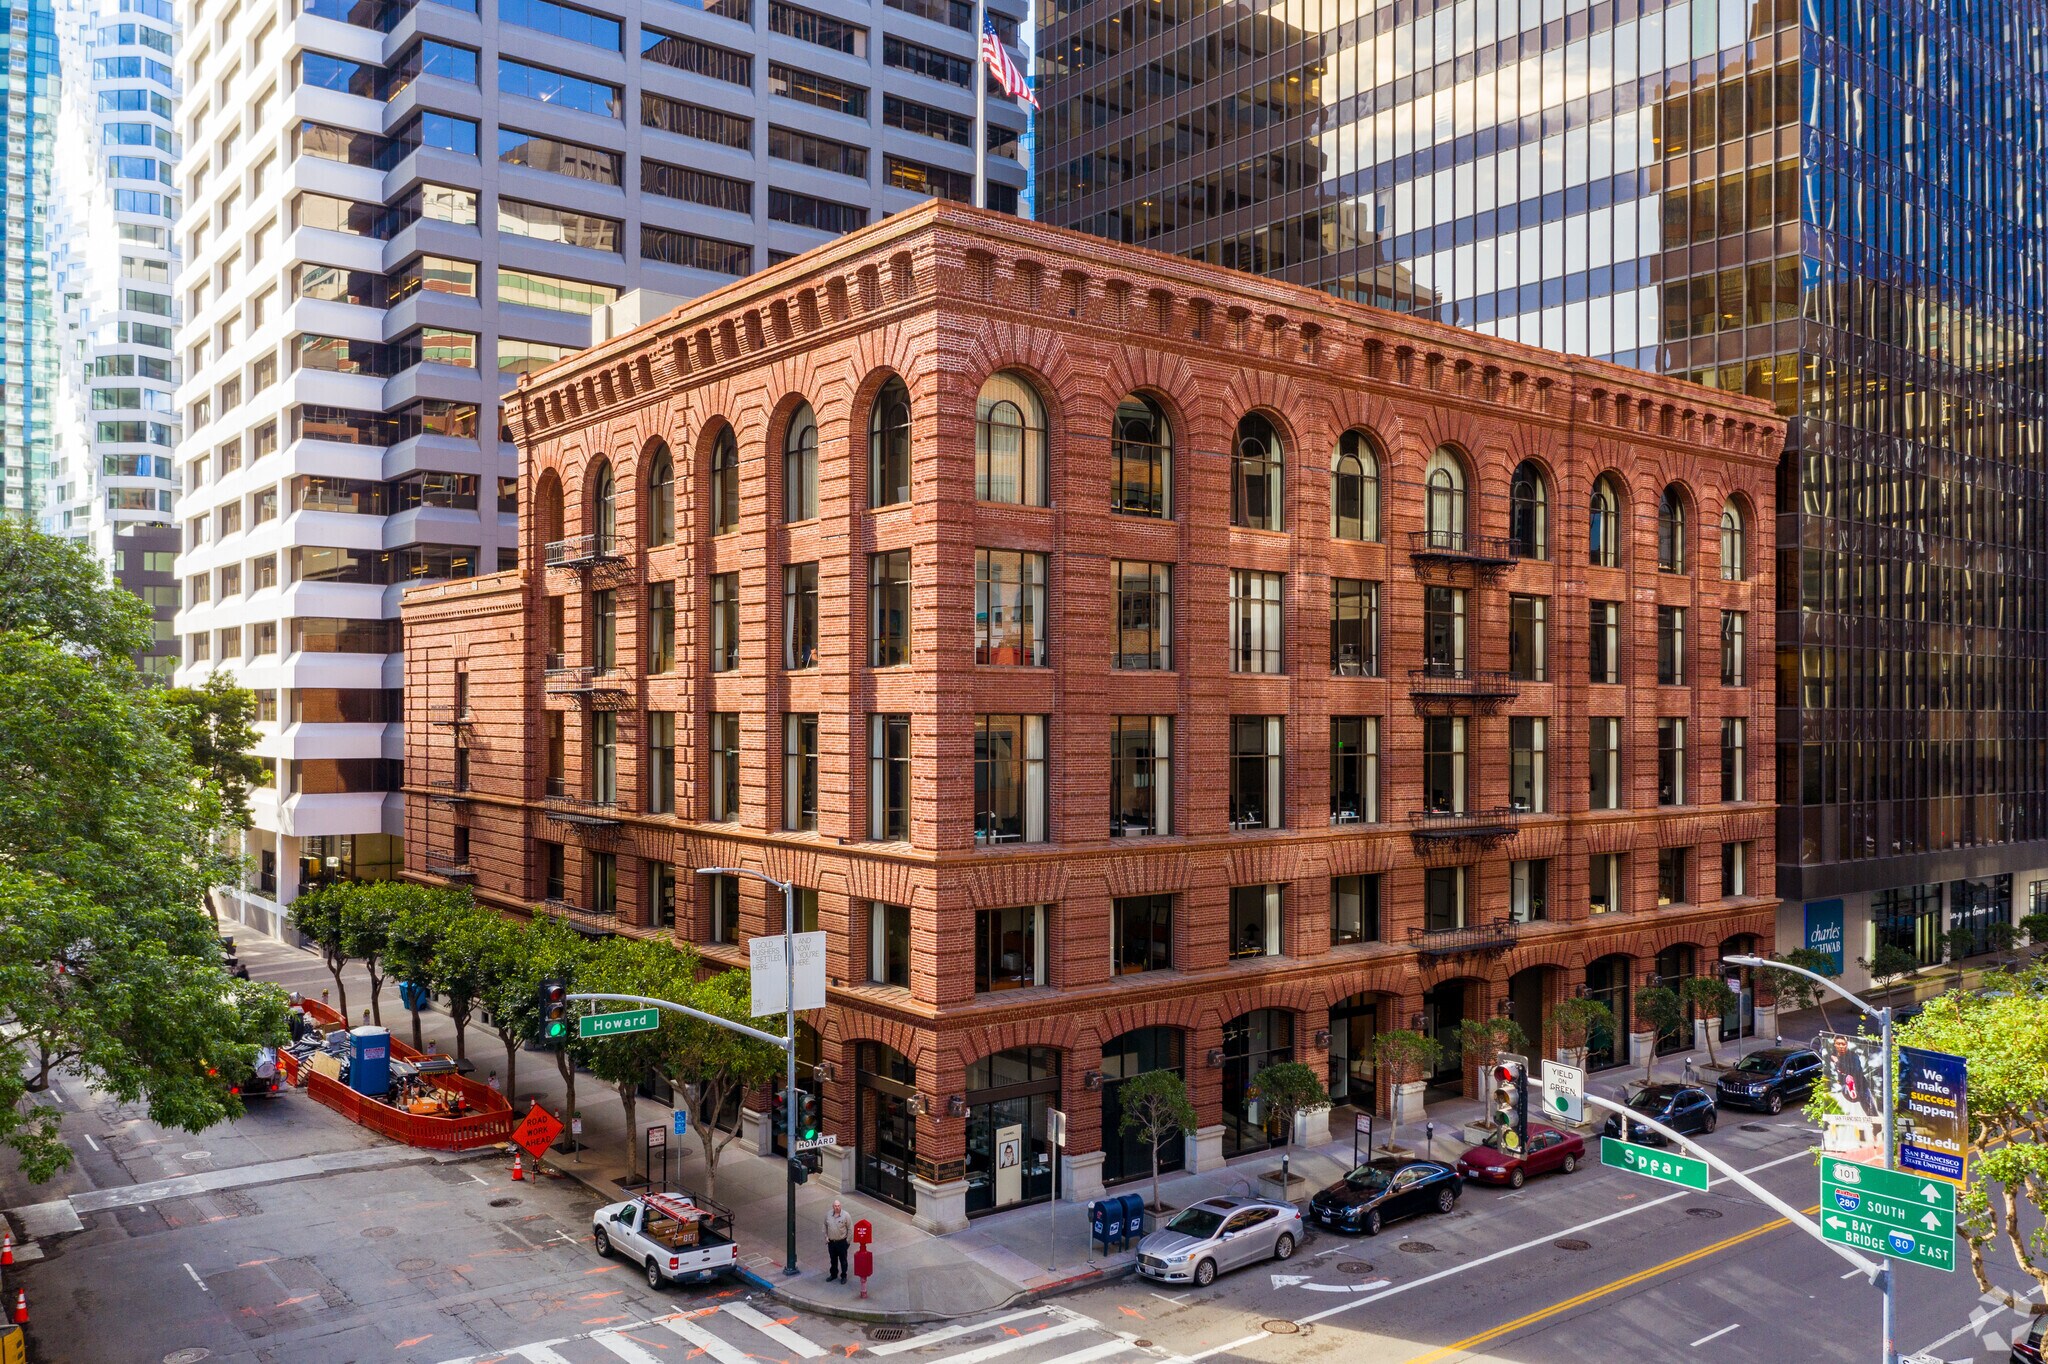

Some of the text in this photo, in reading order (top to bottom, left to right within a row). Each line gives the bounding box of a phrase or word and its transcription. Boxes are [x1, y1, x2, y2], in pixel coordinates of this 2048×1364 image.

[1810, 921, 1841, 943] charles
[756, 940, 774, 948] GOLD
[752, 948, 780, 956] RUSHERS
[756, 955, 782, 963] SETTLED
[593, 1014, 647, 1031] Howard
[1552, 1067, 1574, 1080] YIELD
[1923, 1068, 1943, 1082] We
[1558, 1077, 1567, 1085] ON
[1916, 1081, 1950, 1095] make
[1550, 1082, 1576, 1096] GREEN
[1910, 1091, 1957, 1108] success
[1908, 1100, 1959, 1119] happen.
[526, 1115, 548, 1127] ROAD
[526, 1126, 548, 1137] WORK
[525, 1135, 552, 1147] AHEAD
[798, 1137, 834, 1149] HOWARD
[1905, 1132, 1960, 1151] sfsu.edu
[1624, 1148, 1684, 1177] Spear
[1904, 1148, 1960, 1167] SAN FRANCISCO
[1904, 1156, 1959, 1175] STATE UNIVERSITY
[1840, 1169, 1855, 1179] 101
[1839, 1197, 1906, 1220] 280 SOUTH
[1852, 1219, 1873, 1234] BAY
[1845, 1230, 1949, 1261] BRIDGE 80 EAST
